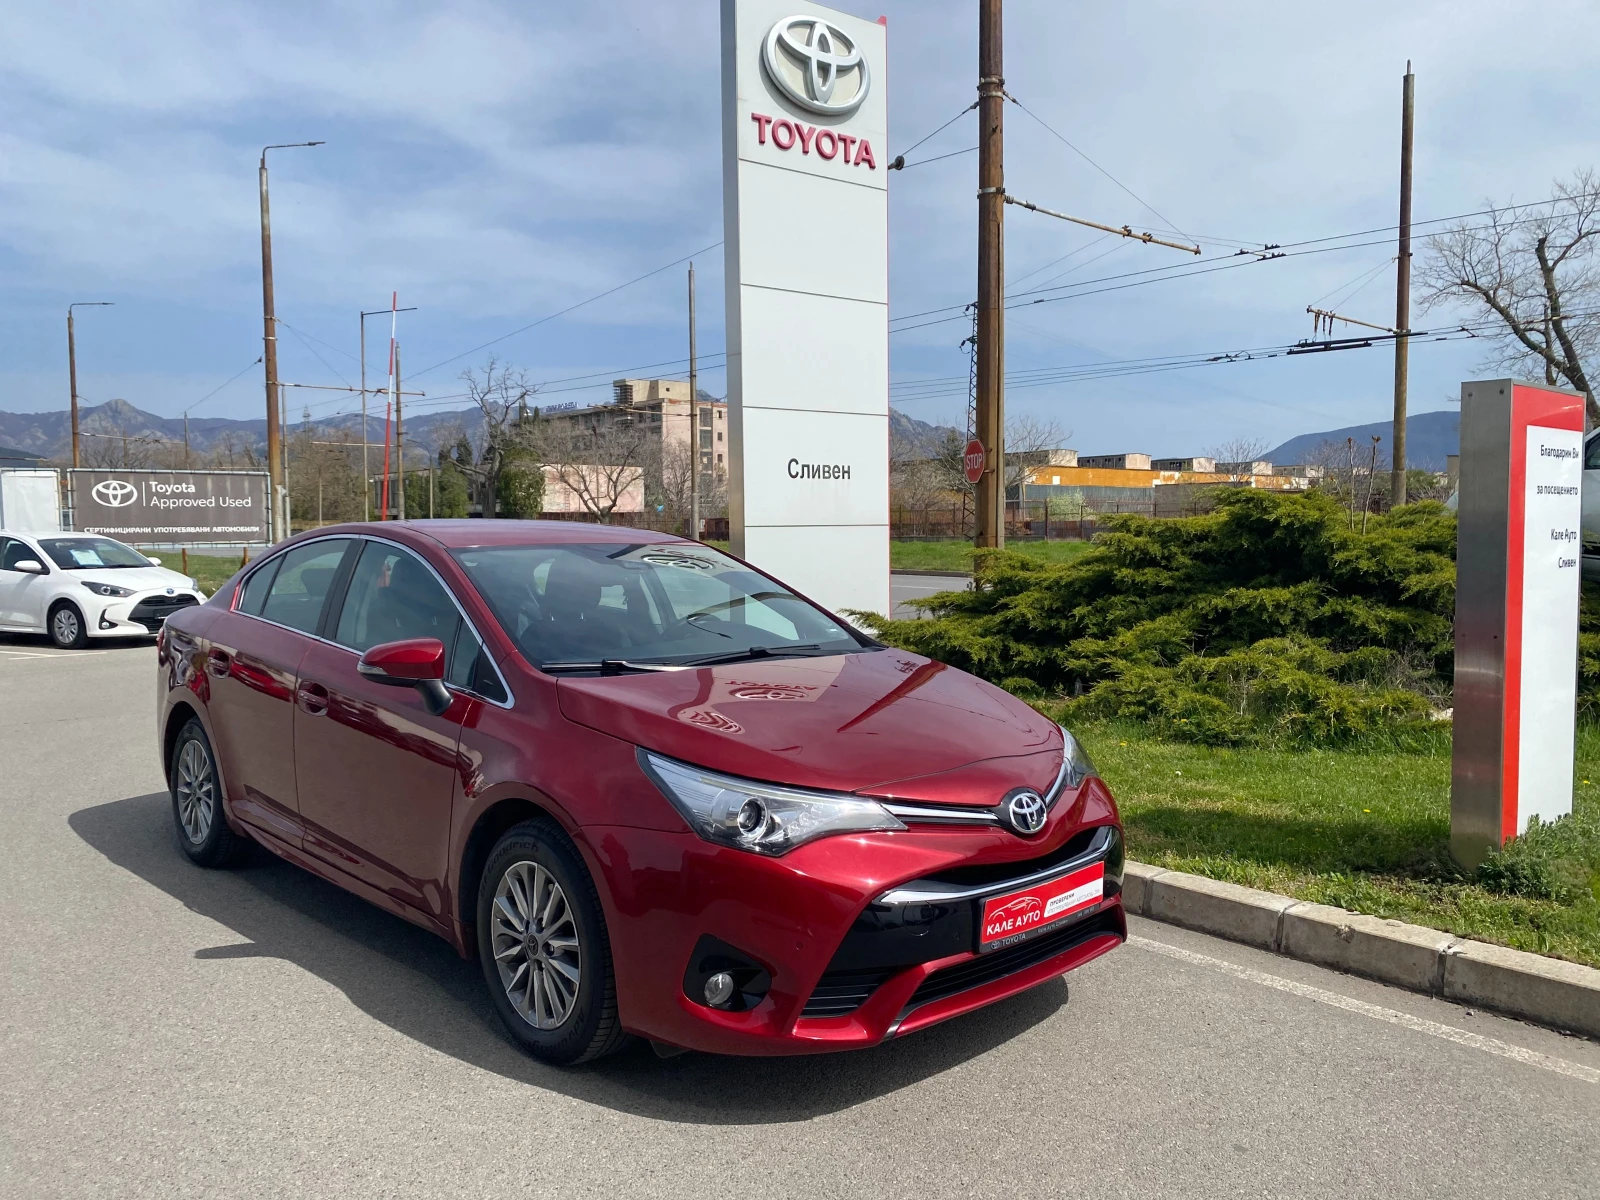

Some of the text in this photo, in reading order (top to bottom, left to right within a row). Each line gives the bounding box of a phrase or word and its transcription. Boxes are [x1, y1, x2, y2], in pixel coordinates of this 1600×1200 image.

[751, 112, 876, 169] TOYOTA
[1572, 447, 1579, 459] Ви
[966, 452, 983, 470] STOP
[787, 458, 851, 480] Сливен
[149, 481, 196, 495] Toyota
[1537, 485, 1578, 496] за посещението
[150, 496, 252, 509] Approved Used
[84, 526, 151, 534] СЕРТИФИЦИРАНИ
[1550, 528, 1577, 543] Кале Ауто
[1558, 557, 1576, 568] Сливен
[986, 918, 1014, 936] КАЛЕ
[1015, 910, 1041, 928] АУТО
[1002, 933, 1026, 946] TOYOTA
